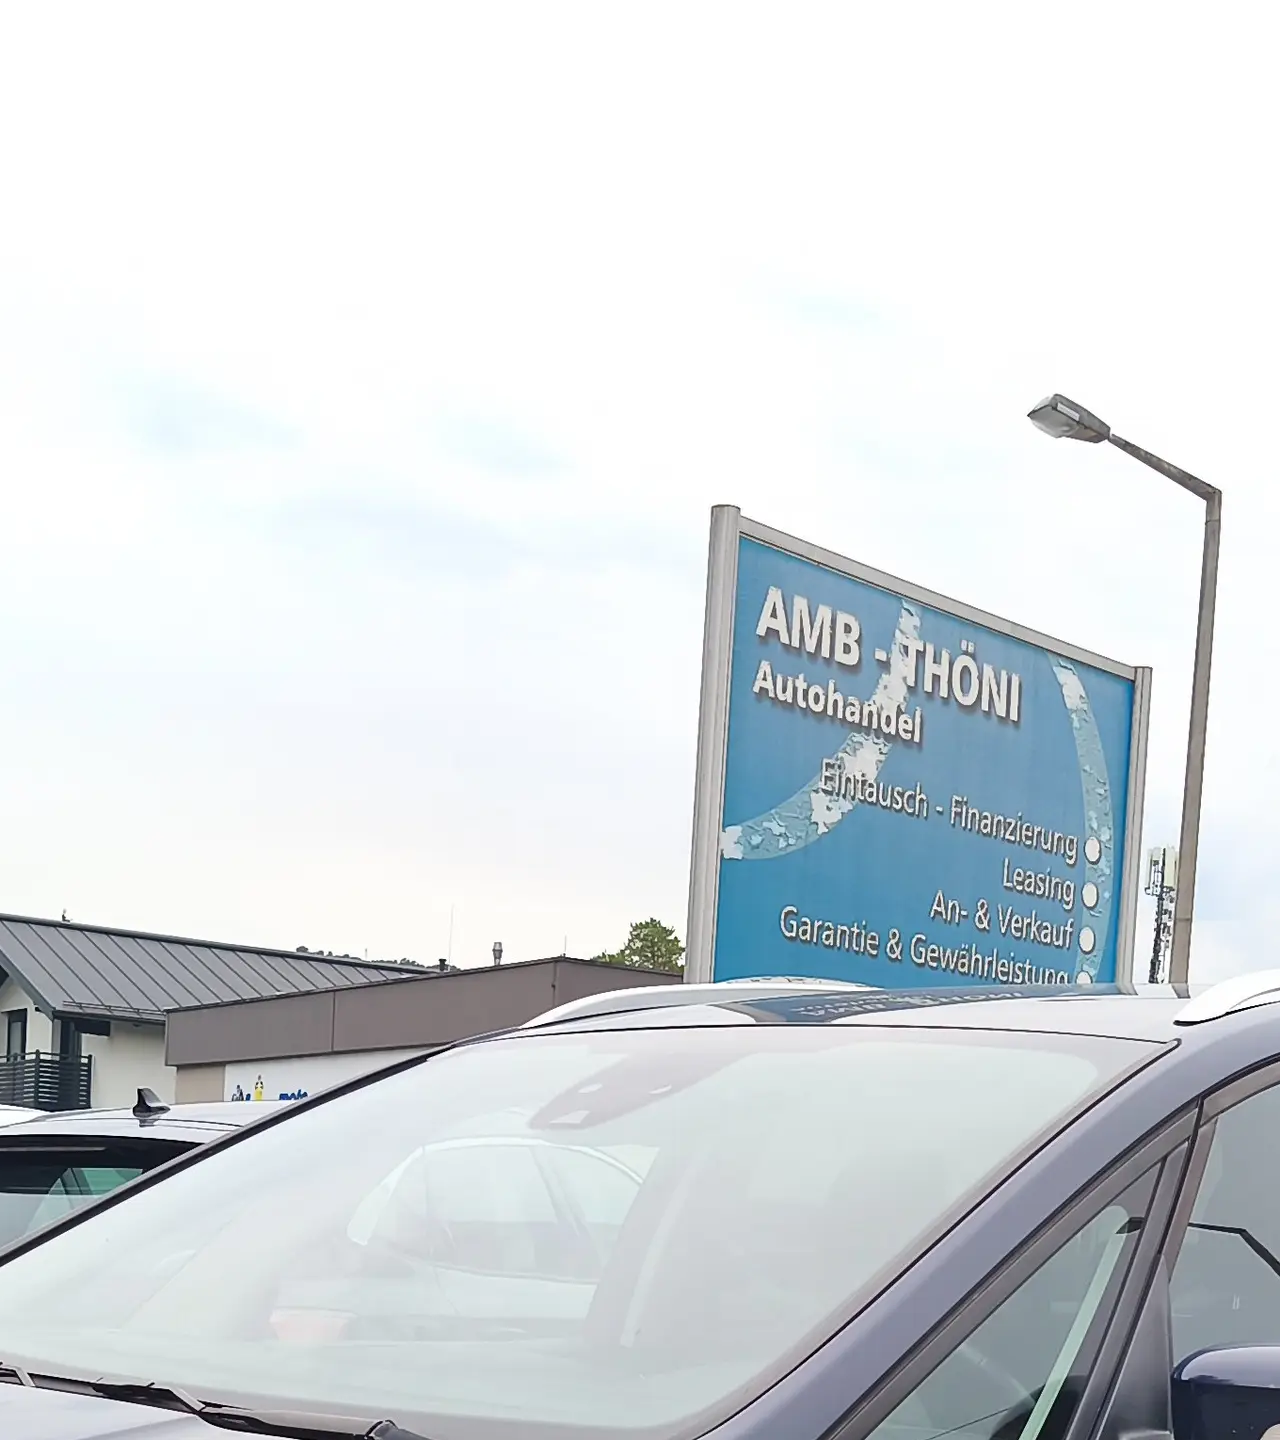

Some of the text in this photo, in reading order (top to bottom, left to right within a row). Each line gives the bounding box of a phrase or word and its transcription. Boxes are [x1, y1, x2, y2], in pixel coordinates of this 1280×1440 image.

[756, 585, 861, 667] AMB
[897, 637, 1020, 722] THÖNI
[753, 660, 922, 743] Autohandel
[820, 757, 928, 818] Eintausch
[949, 795, 1078, 865] Finanzierung
[930, 889, 1074, 949] An- & Verkauf
[1002, 857, 1075, 911] Leasing
[780, 905, 880, 956] Garantie
[886, 928, 902, 961] &
